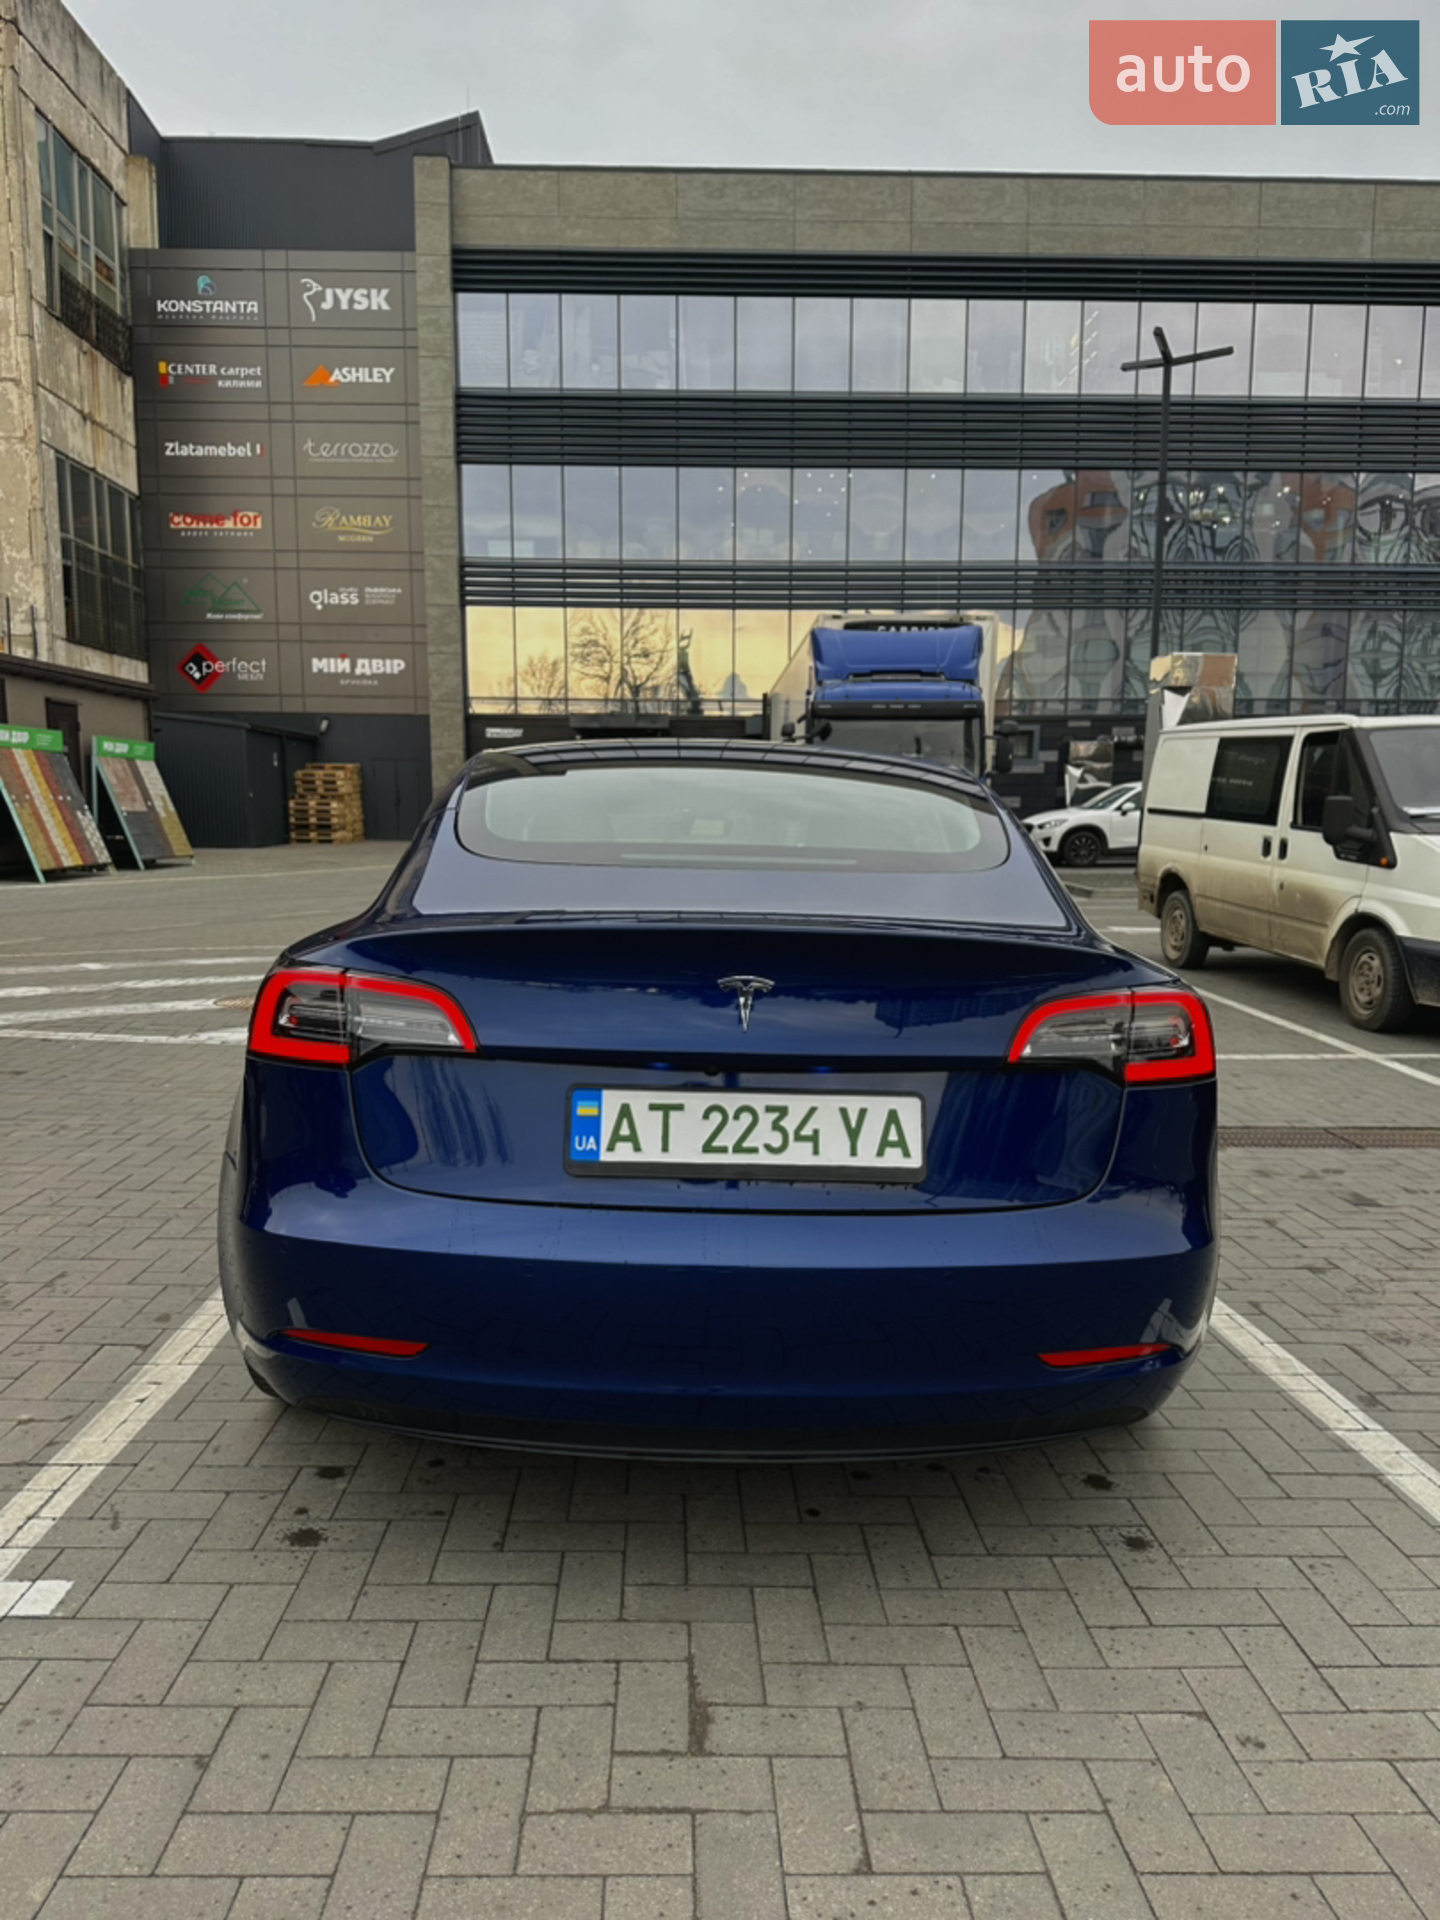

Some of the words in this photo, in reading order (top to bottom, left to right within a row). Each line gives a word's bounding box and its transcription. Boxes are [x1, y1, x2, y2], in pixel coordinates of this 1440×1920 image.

[156, 299, 259, 314] KONSTANTA
[320, 287, 391, 311] JYSK
[220, 365, 262, 378] carpet
[329, 366, 395, 383] ASHLEY
[164, 441, 252, 457] Zlatamebel
[309, 588, 359, 610] glass
[202, 657, 267, 676] perfect
[354, 658, 406, 676] ДВІР
[606, 1103, 684, 1152] AT
[701, 1104, 820, 1155] 2234
[838, 1107, 912, 1158] YA
[575, 1136, 598, 1151] UA
